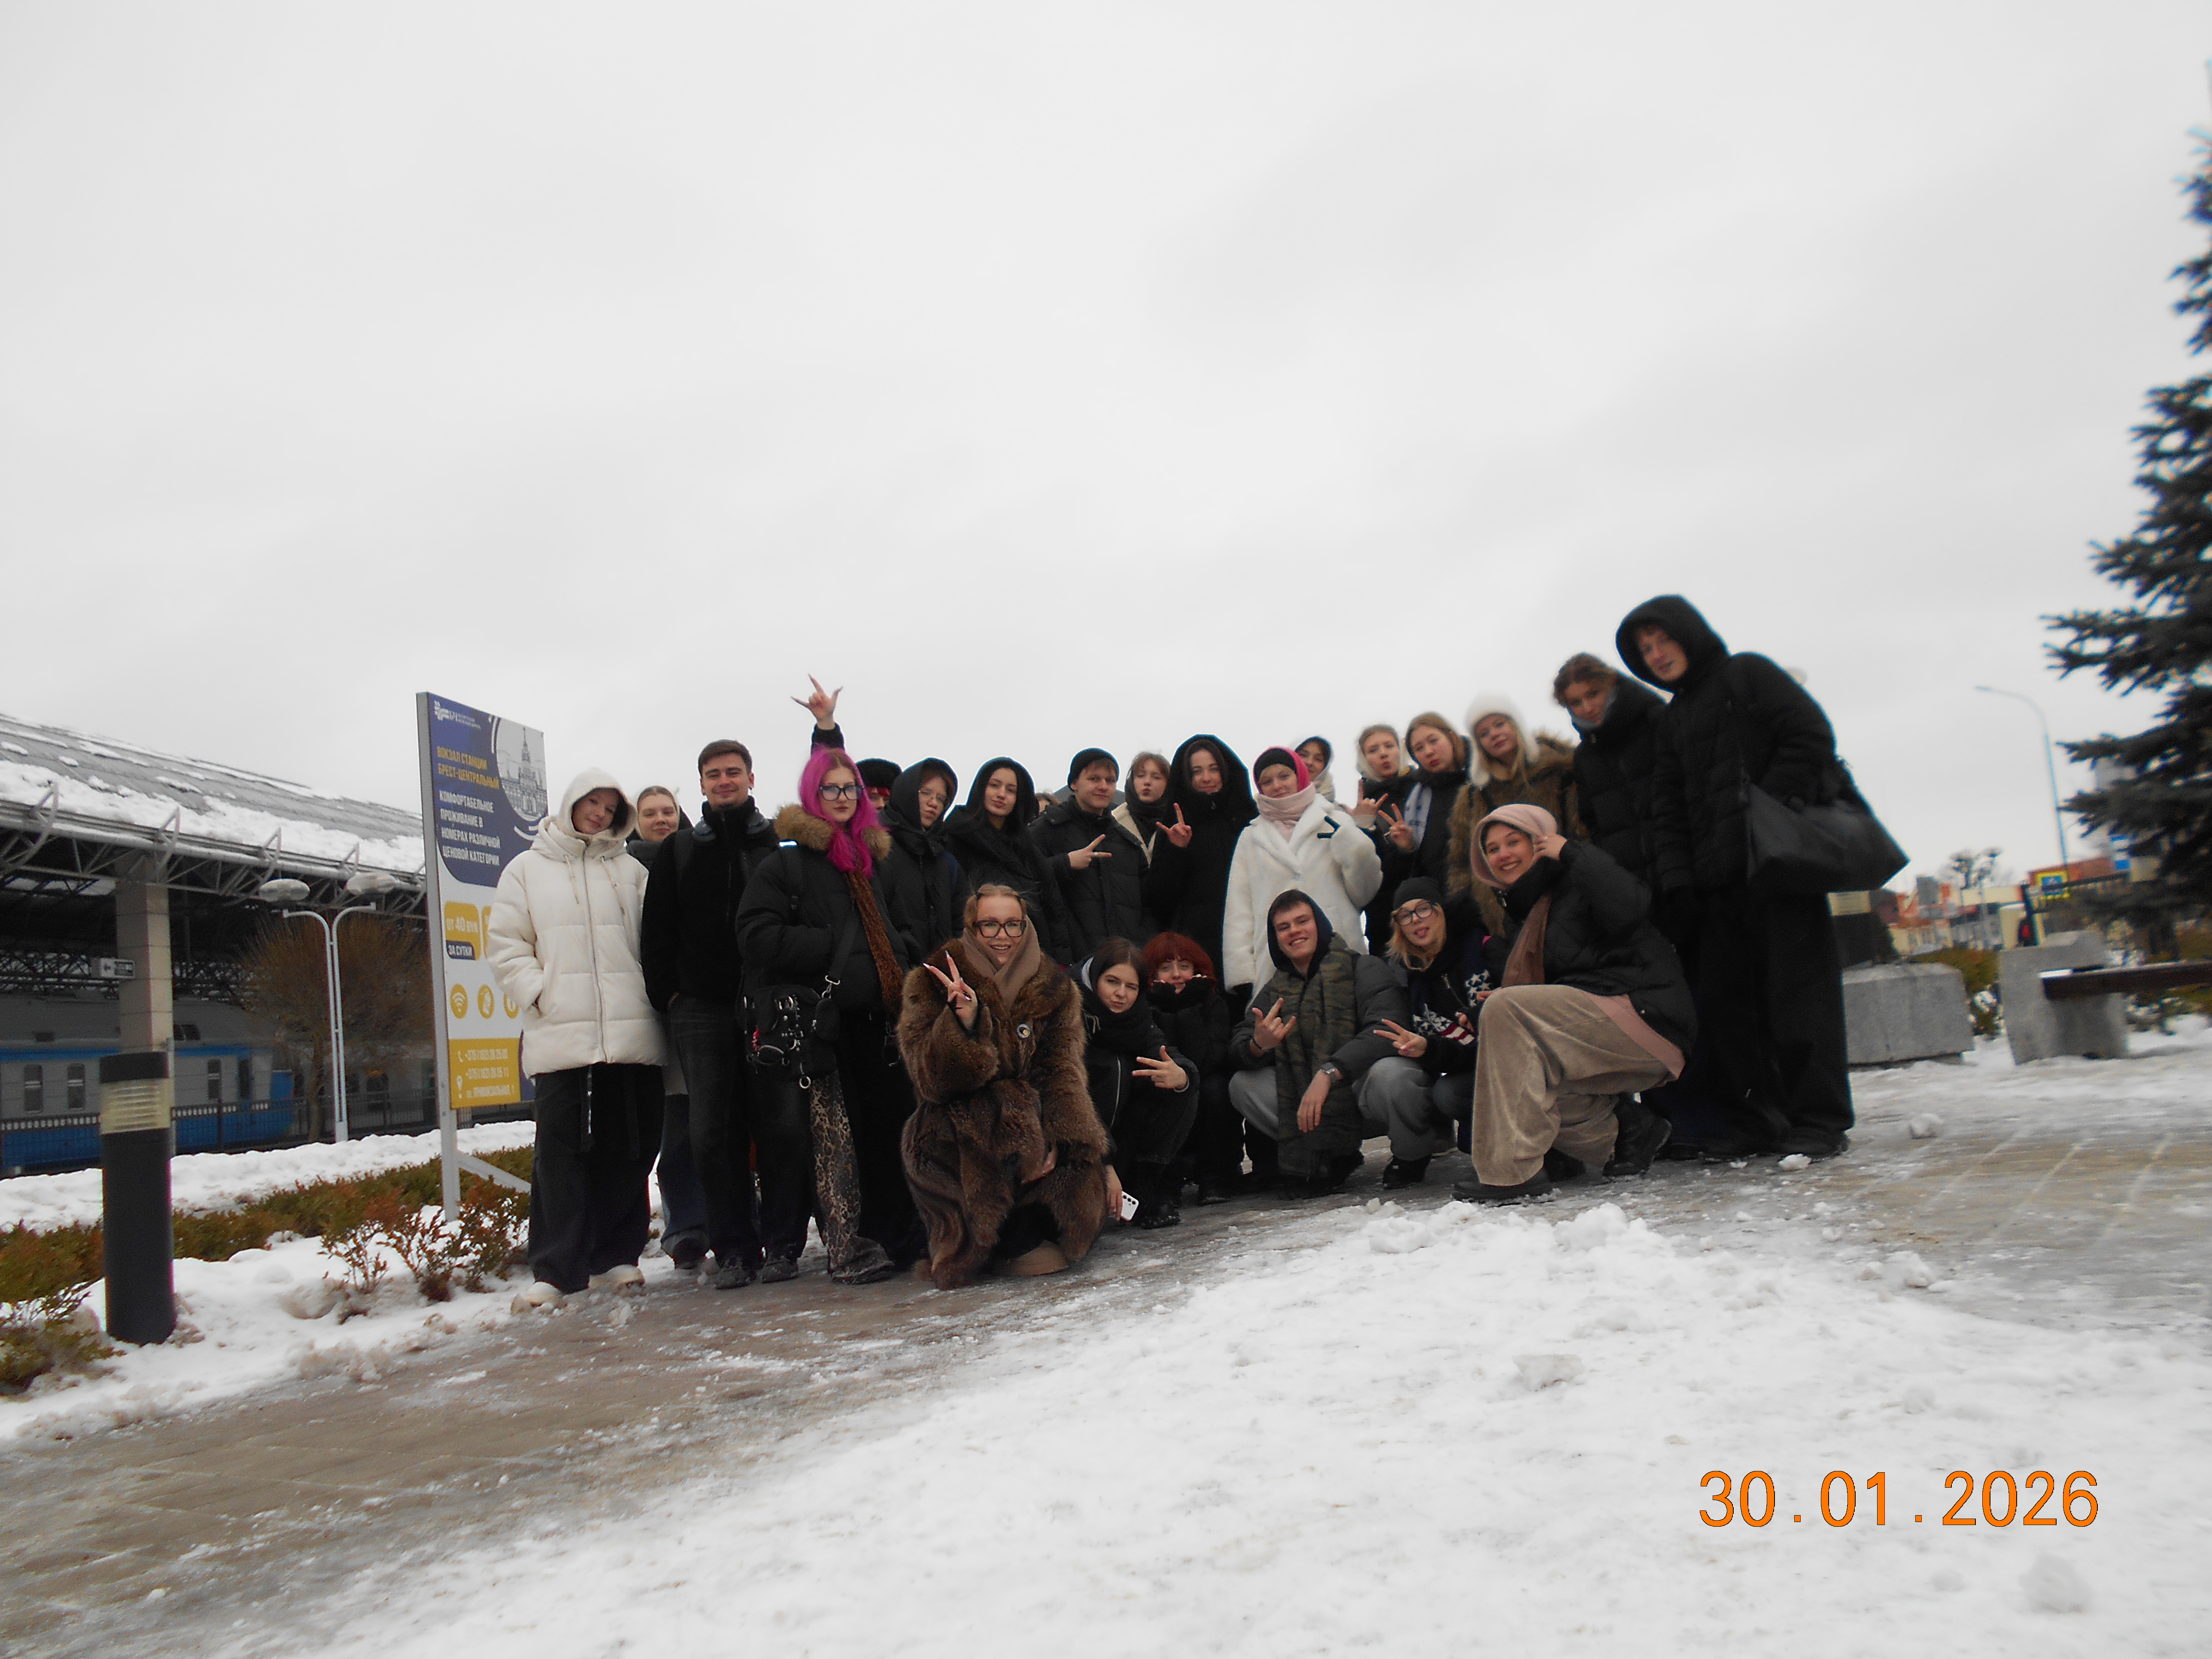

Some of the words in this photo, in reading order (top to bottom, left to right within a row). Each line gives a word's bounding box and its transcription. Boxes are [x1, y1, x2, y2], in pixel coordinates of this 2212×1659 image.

[437, 746, 460, 762] ВОКЗАЛ
[461, 753, 487, 769] СТАНЦИИ
[438, 763, 499, 789] БРЕСТ-ЦЕНТРАЛЬНЫЙ
[439, 790, 494, 813] КОМФОРТАБЕЛЬНОЕ
[441, 808, 478, 827] ПРОЖИВАНИЕ
[479, 816, 483, 828] В
[441, 827, 468, 842] НОМЕРАХ
[469, 832, 501, 848] РАЗЛИЧНОЙ
[443, 845, 469, 860] ЦЕНОВОЙ
[469, 850, 500, 866] КАТЕГОРИИ
[448, 945, 456, 955] ЗА
[456, 945, 473, 957] СУТКИ
